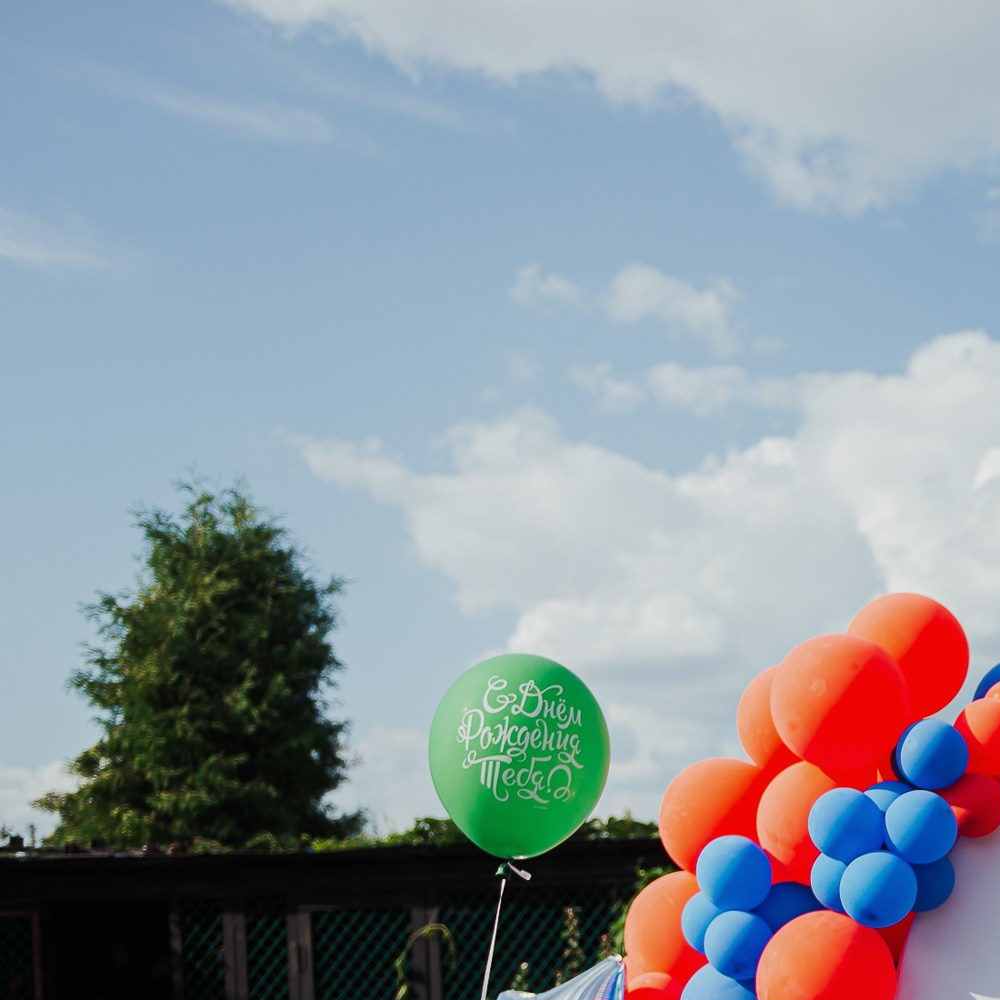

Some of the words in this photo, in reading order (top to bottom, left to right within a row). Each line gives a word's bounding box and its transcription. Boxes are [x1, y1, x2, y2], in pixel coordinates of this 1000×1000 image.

[482, 675, 517, 714] С
[511, 680, 582, 730] Днём
[456, 706, 584, 769] Рождения
